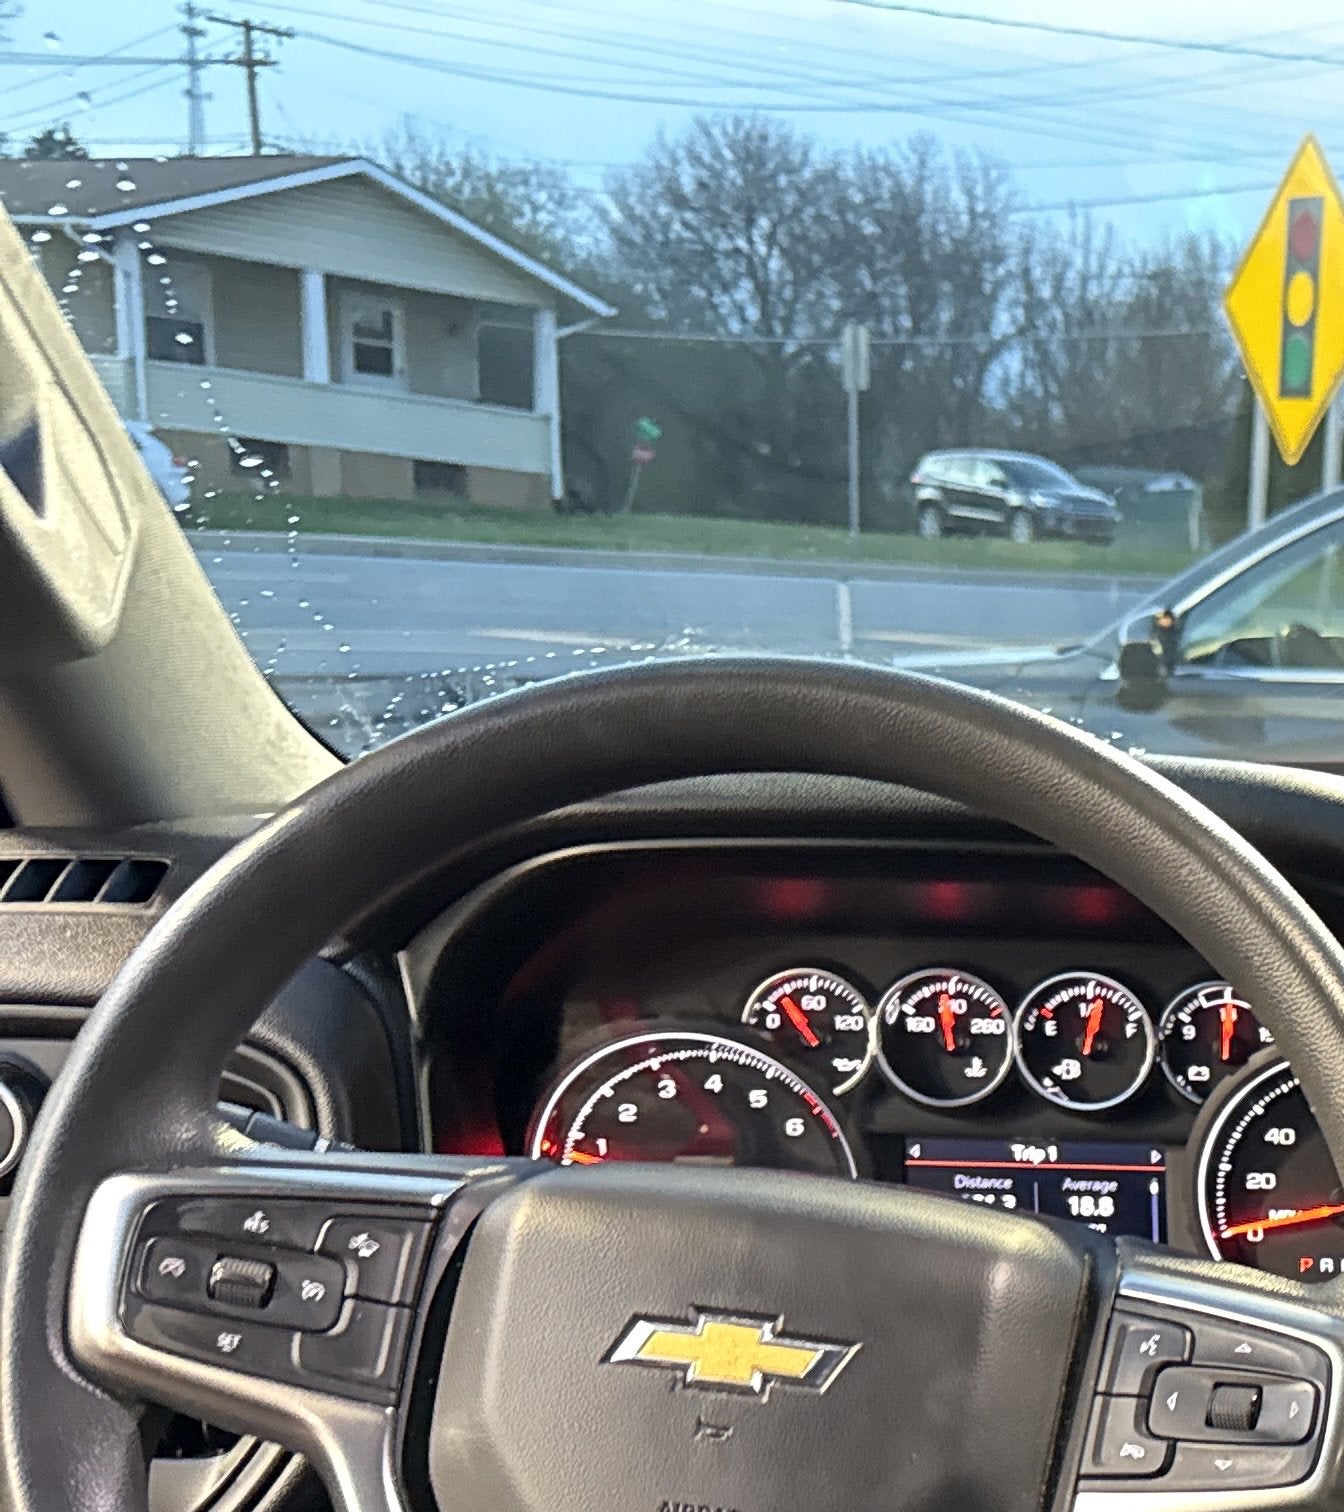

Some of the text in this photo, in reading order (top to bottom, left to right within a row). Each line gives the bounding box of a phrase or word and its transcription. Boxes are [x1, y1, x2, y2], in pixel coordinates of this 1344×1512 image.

[801, 995, 827, 1011] 60
[765, 1014, 781, 1030] 0
[833, 1015, 864, 1031] 120
[905, 1016, 936, 1033] 160
[970, 1018, 1006, 1034] 260
[1044, 1022, 1058, 1037] E
[1125, 1022, 1139, 1039] F
[1182, 1024, 1196, 1040] 9
[657, 1078, 677, 1099] 3
[703, 1074, 723, 1094] 4
[748, 1089, 769, 1109] 5
[617, 1103, 638, 1123] 2
[785, 1117, 805, 1137] 6
[1264, 1127, 1296, 1146] 40
[595, 1138, 608, 1156] 1
[1009, 1143, 1058, 1166] Trip 1
[953, 1173, 1014, 1191] Distance
[1061, 1177, 1119, 1194] Average
[1245, 1172, 1277, 1190] 20
[1299, 1256, 1314, 1273] P
[1319, 1257, 1335, 1273] R
